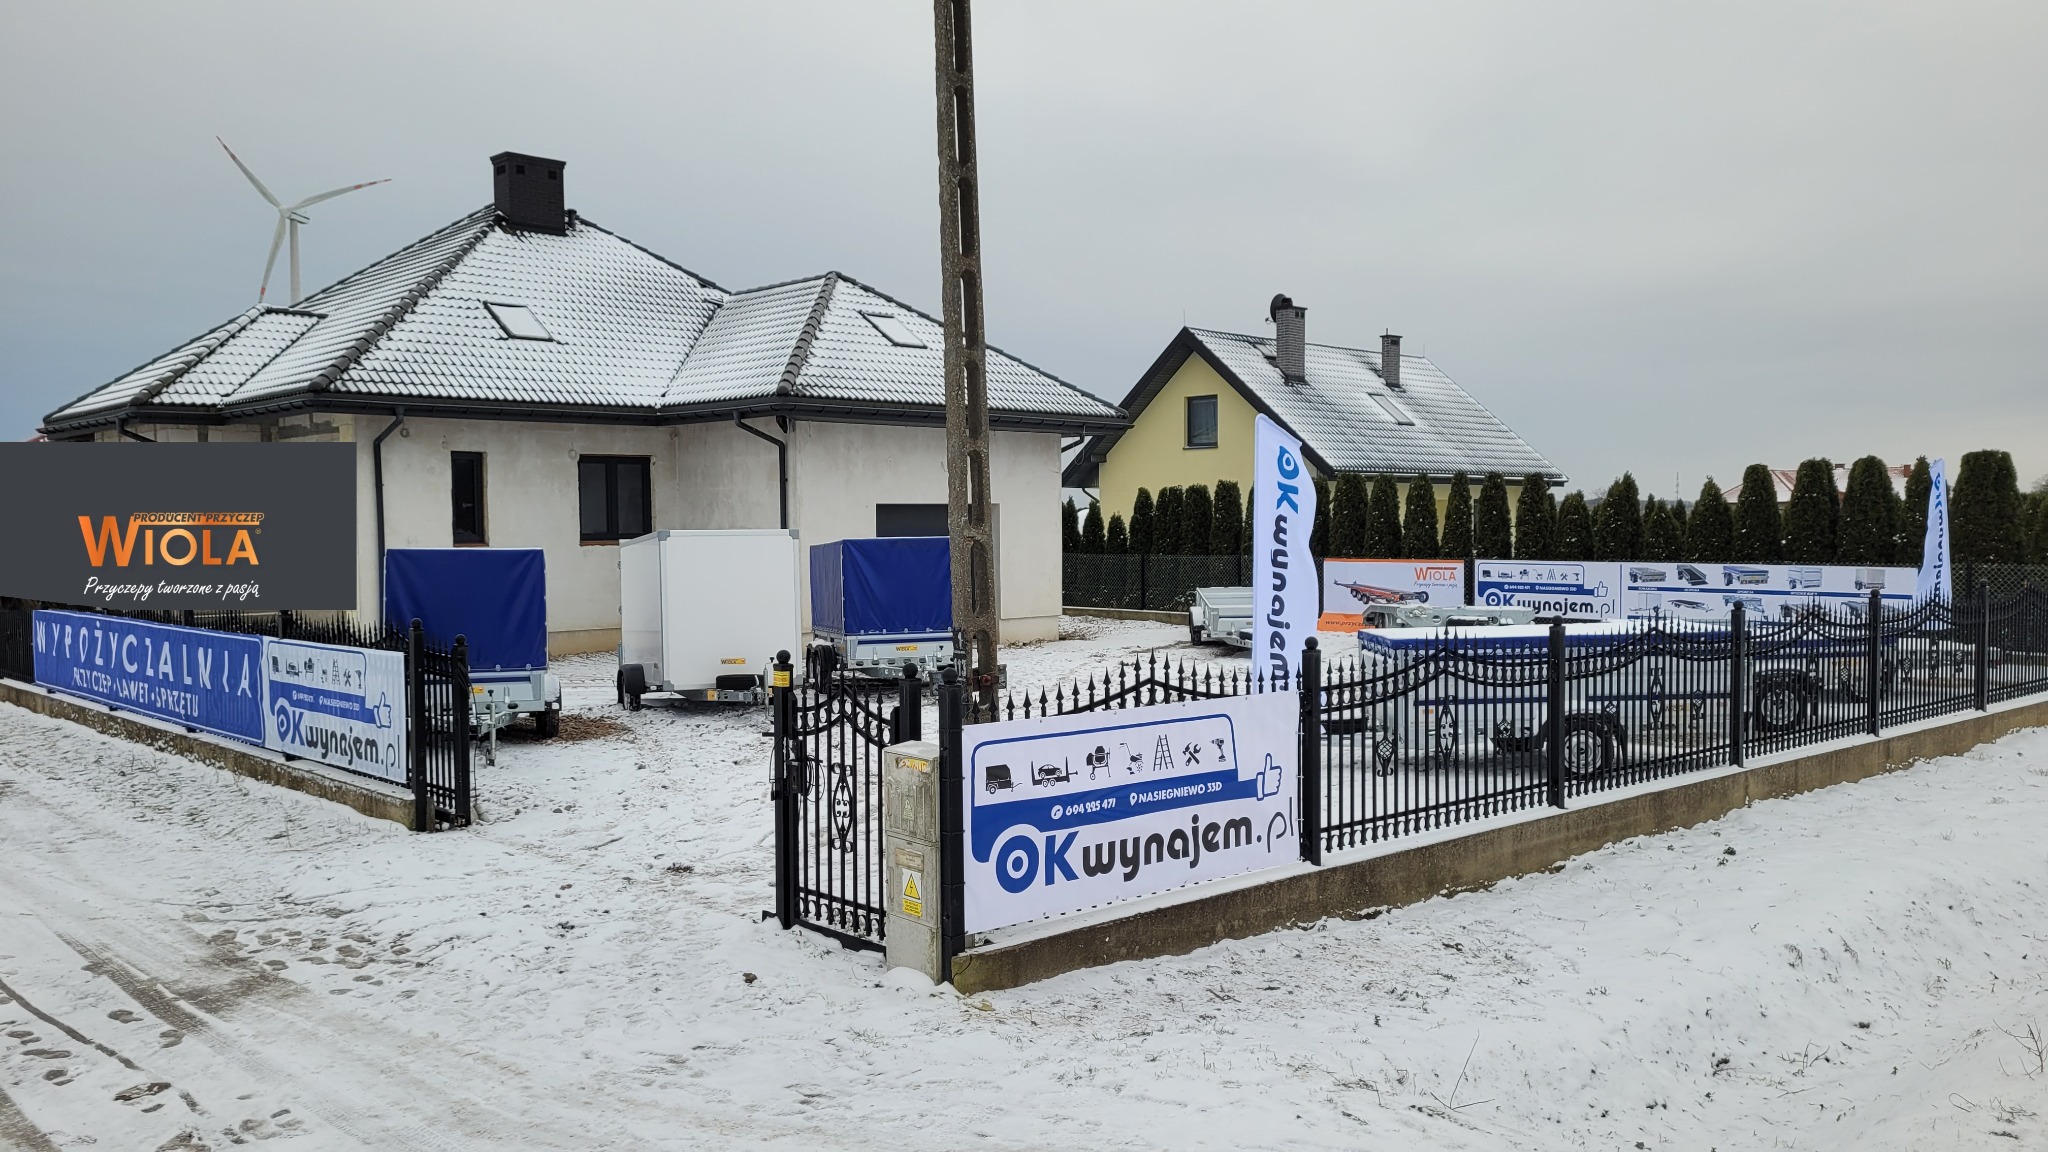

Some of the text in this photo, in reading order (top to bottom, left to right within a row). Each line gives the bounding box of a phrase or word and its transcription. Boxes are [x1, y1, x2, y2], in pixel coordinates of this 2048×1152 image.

[1414, 566, 1457, 581] WIOLA
[35, 620, 252, 699] WYPOŻYCZALNIA
[71, 667, 199, 720] PRZYCZEP LAWET SPRZĘTU
[1065, 798, 1116, 816] 694 225 471
[1138, 781, 1223, 804] NASIEGNIEWO 33D
[995, 796, 1294, 894] OKwynajem.pl
